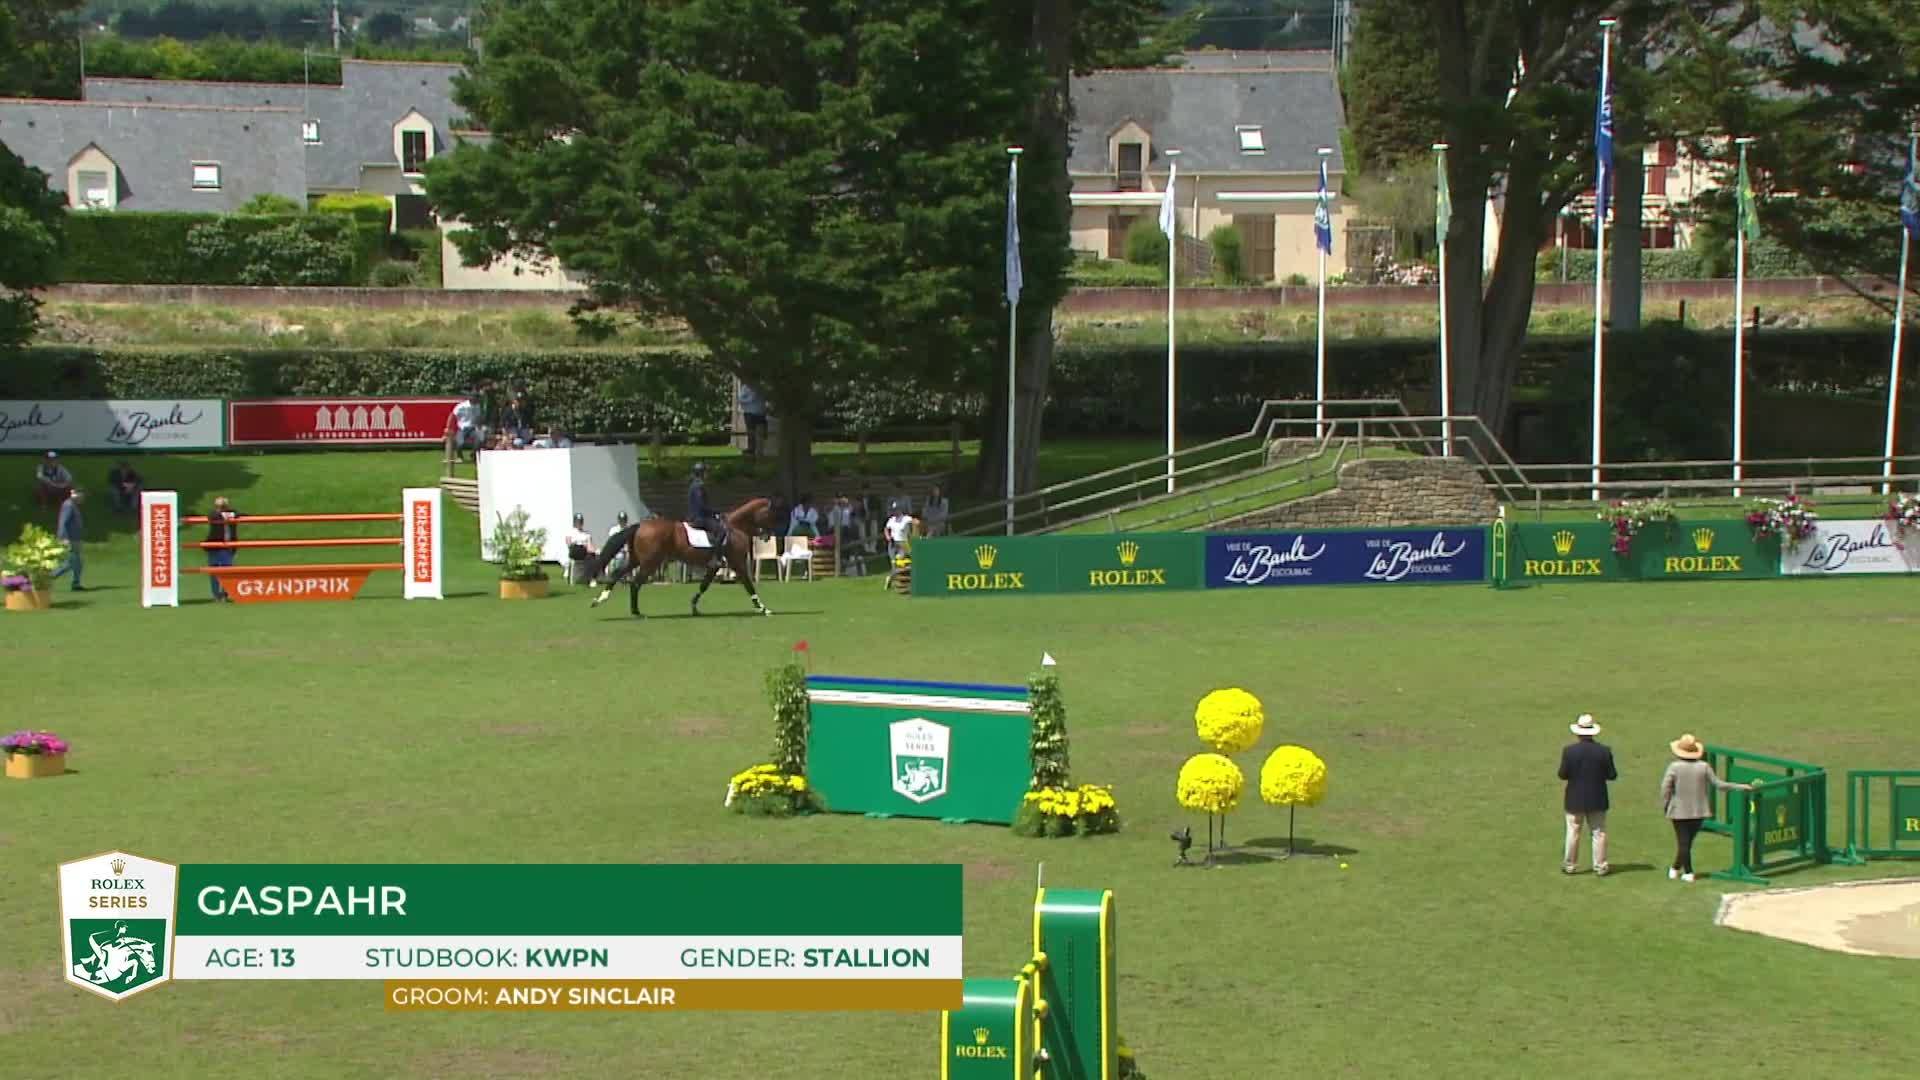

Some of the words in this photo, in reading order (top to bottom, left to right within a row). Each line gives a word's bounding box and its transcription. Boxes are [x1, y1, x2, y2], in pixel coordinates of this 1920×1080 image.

[122, 403, 203, 445] Baule
[154, 507, 167, 584] GRANDPRIX
[416, 504, 429, 579] GRANDPRIX
[1801, 543, 1829, 568] La
[1823, 523, 1892, 570] Baule
[1245, 534, 1326, 584] Baule
[1384, 531, 1466, 581] Baule
[1664, 555, 1743, 573] ROLEX
[1524, 559, 1602, 576] ROLEX
[236, 577, 350, 596] GRANDPRIX
[947, 573, 1024, 590] ROLEX
[1089, 569, 1166, 587] ROLEX
[1764, 827, 1799, 845] ROLEX
[956, 1045, 1008, 1058] ROLEX
